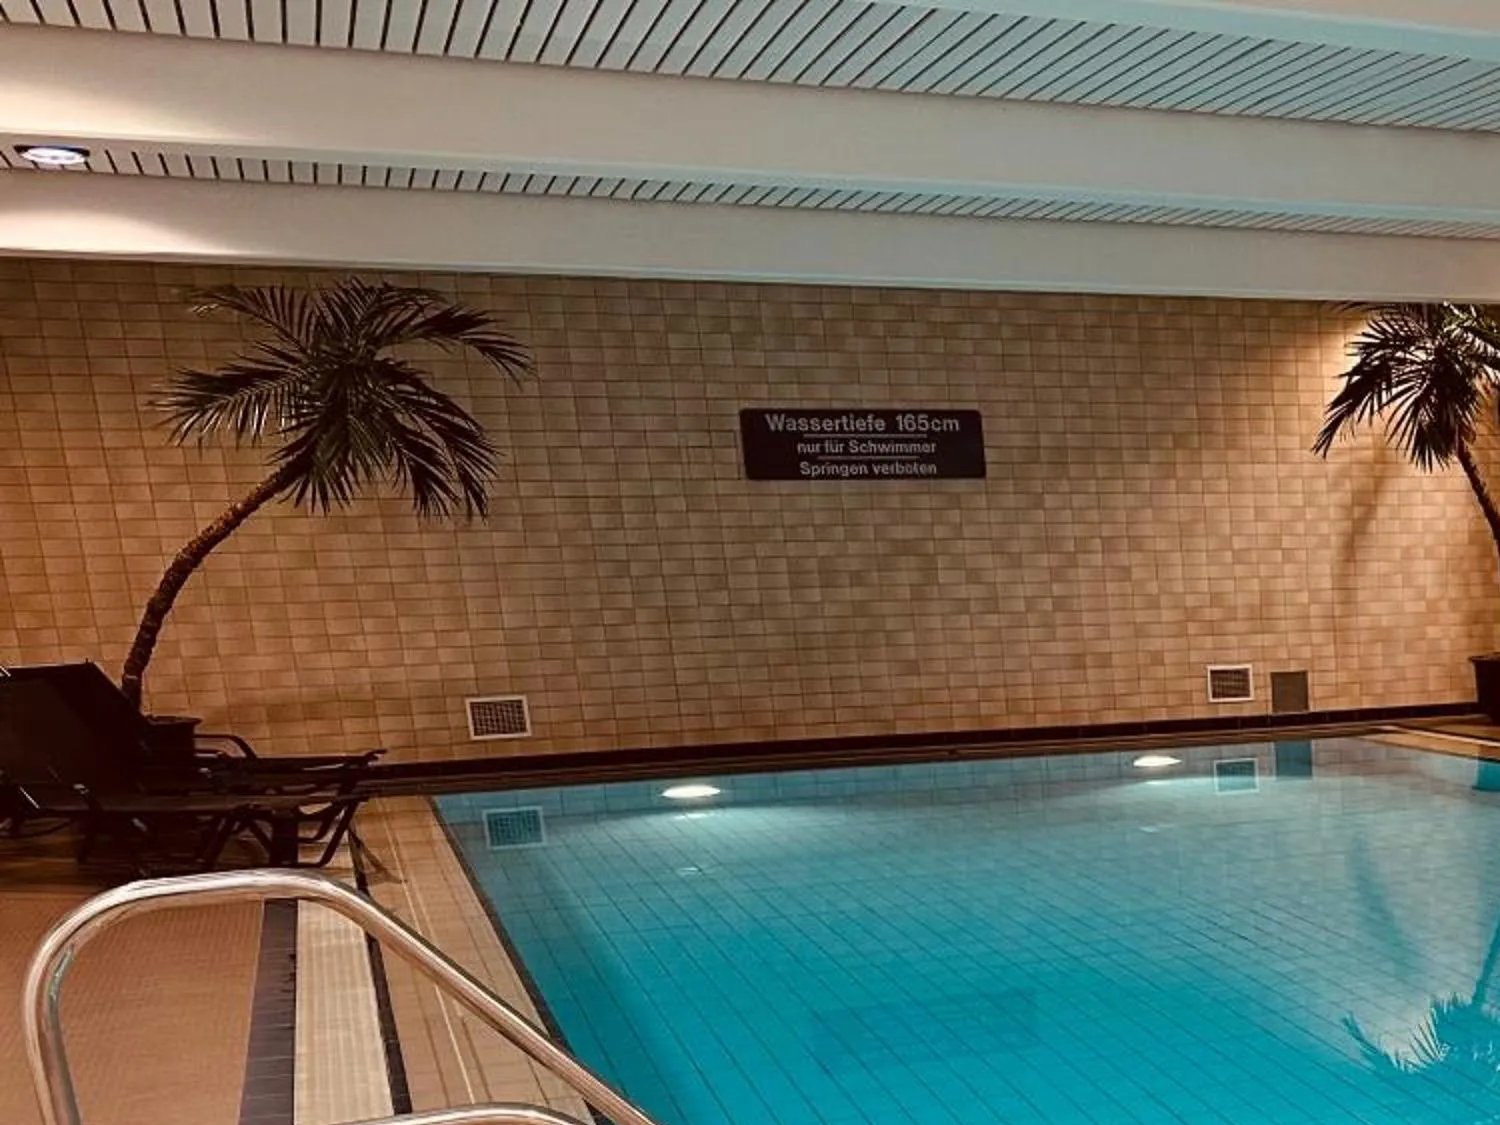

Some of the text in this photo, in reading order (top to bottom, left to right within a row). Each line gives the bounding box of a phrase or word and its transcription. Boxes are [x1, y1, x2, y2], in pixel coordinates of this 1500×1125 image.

[764, 413, 961, 432] Wassertiefe 165cm
[796, 438, 936, 454] nur für Schwimmer
[799, 461, 937, 477] Springen verboten
